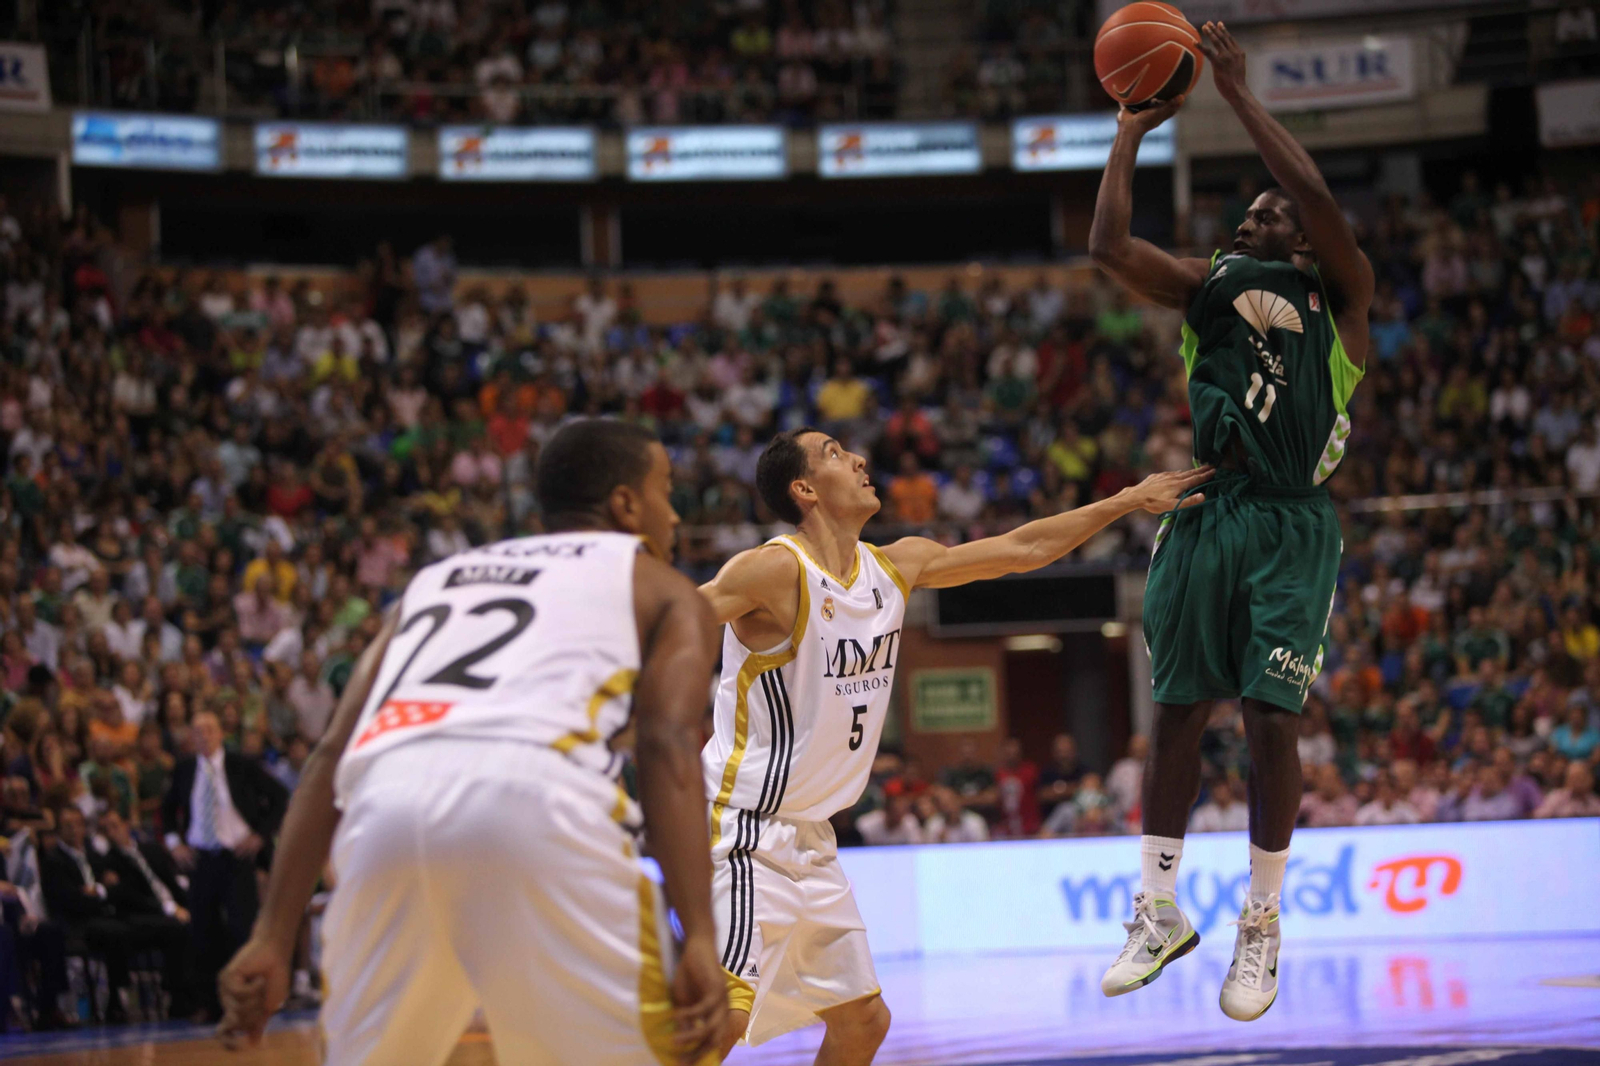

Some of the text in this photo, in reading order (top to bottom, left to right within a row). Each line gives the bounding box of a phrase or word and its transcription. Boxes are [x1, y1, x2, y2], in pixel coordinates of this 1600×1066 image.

[376, 597, 536, 712] 22
[820, 629, 901, 679] MMT
[834, 675, 889, 697] SGUROS
[848, 704, 868, 752] 5
